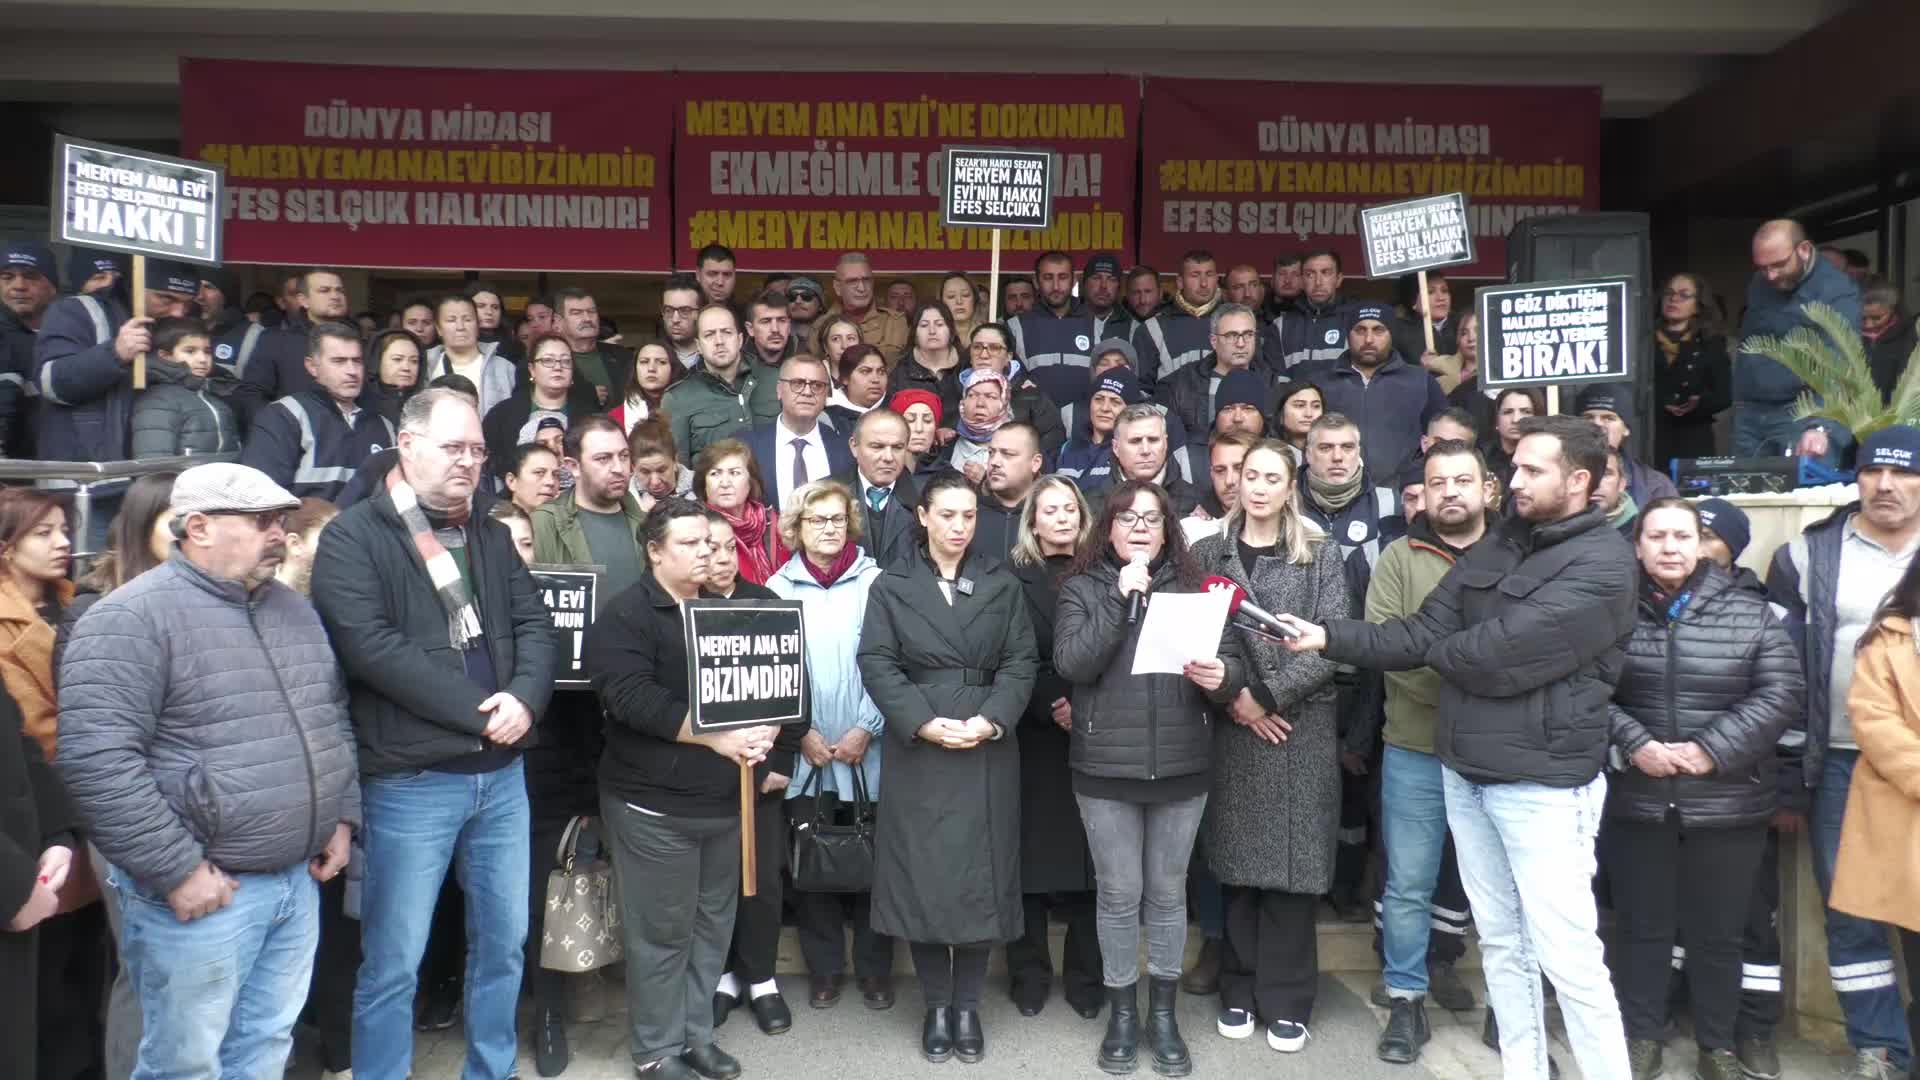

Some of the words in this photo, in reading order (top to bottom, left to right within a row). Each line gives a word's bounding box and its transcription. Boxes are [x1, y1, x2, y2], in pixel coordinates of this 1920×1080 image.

[304, 100, 424, 141] DÜNYA
[431, 103, 552, 143] MİRASI
[686, 100, 810, 137] MERYEM
[815, 101, 878, 137] ANA
[981, 103, 1125, 138] DOKUNMA
[1258, 115, 1369, 153] DÜNYA
[1374, 117, 1490, 155] MİRASI
[75, 162, 144, 188] MERYEM
[146, 174, 178, 194] ANA
[710, 140, 921, 196] EKMEĞİMLE
[954, 167, 1010, 184] MERYEM
[1013, 169, 1042, 185] ANA
[989, 158, 1013, 169] HAKKI
[75, 180, 109, 199] EFES
[954, 183, 999, 201] EVİ'NİN
[1002, 187, 1042, 203] HAKKI
[74, 197, 184, 246] HAKKI
[223, 187, 280, 222] FES
[284, 189, 409, 231] SELÇUK
[415, 191, 649, 230] HALKININDIR!
[953, 200, 982, 215] EFES
[985, 201, 1041, 218] SELÇUK'A
[1163, 201, 1233, 234] EFES
[1238, 202, 1358, 241] SELÇUK
[1371, 214, 1427, 238] MERYEM
[1430, 208, 1460, 229] ANA
[1421, 225, 1463, 245] HAKKI
[1375, 248, 1406, 267] EFES
[1514, 294, 1543, 314] GÖZ
[1502, 340, 1609, 379] BIRAK!
[559, 586, 586, 609] EVİ
[699, 635, 751, 657] MERYEM
[753, 634, 779, 656] ANA
[780, 629, 799, 654] EVİ
[701, 655, 799, 704] BİZİMDİR!
